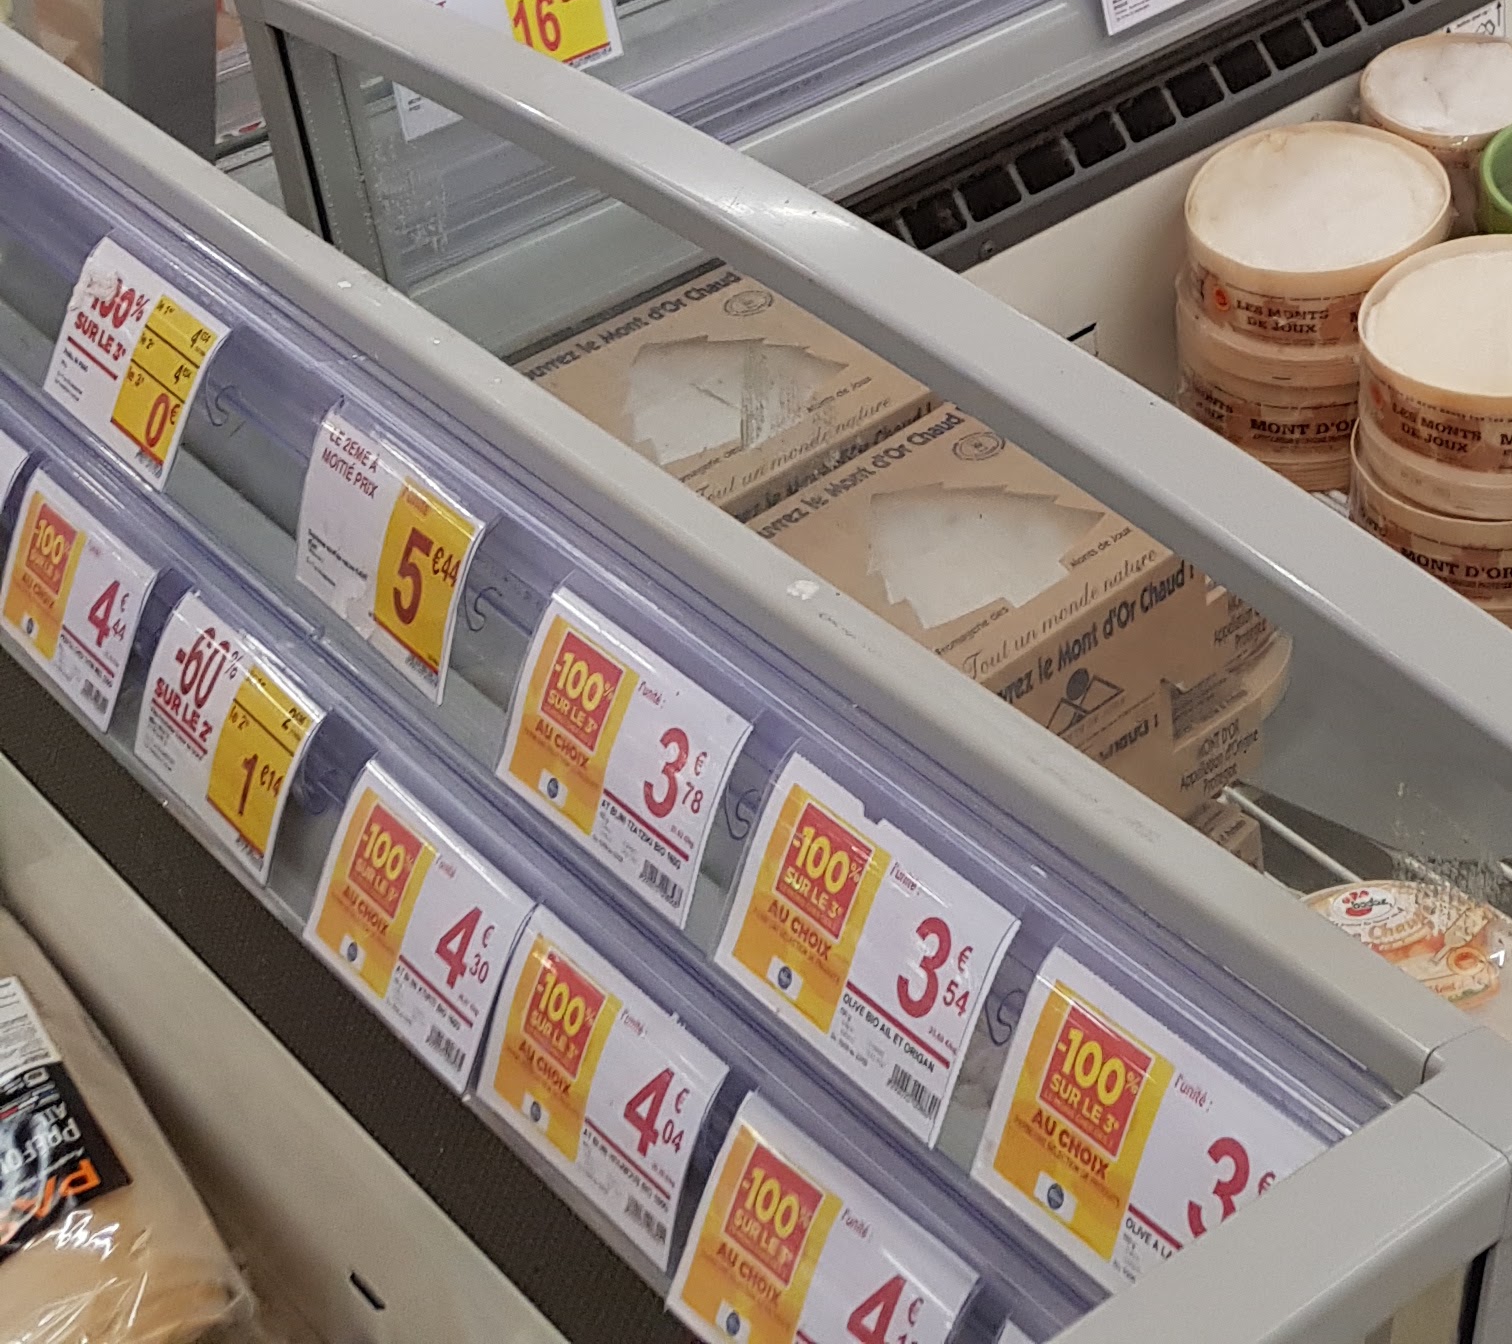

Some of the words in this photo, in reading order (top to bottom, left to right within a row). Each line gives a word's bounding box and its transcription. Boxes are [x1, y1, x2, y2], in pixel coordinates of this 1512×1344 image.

[74, 312, 98, 338] SUR
[1250, 419, 1309, 435] MONT
[1424, 430, 1469, 453] JOUX
[1037, 655, 1055, 688] le
[1057, 627, 1100, 673] Mont
[1102, 594, 1137, 640] d'Or
[1137, 570, 1186, 615] Chaud
[792, 826, 861, 895] -100%
[1057, 1027, 1140, 1107] -100%
[1049, 1075, 1082, 1107] SUR
[1082, 1096, 1103, 1126] LE
[1032, 1108, 1058, 1136] AU
[1058, 1127, 1110, 1181] CHOIX
